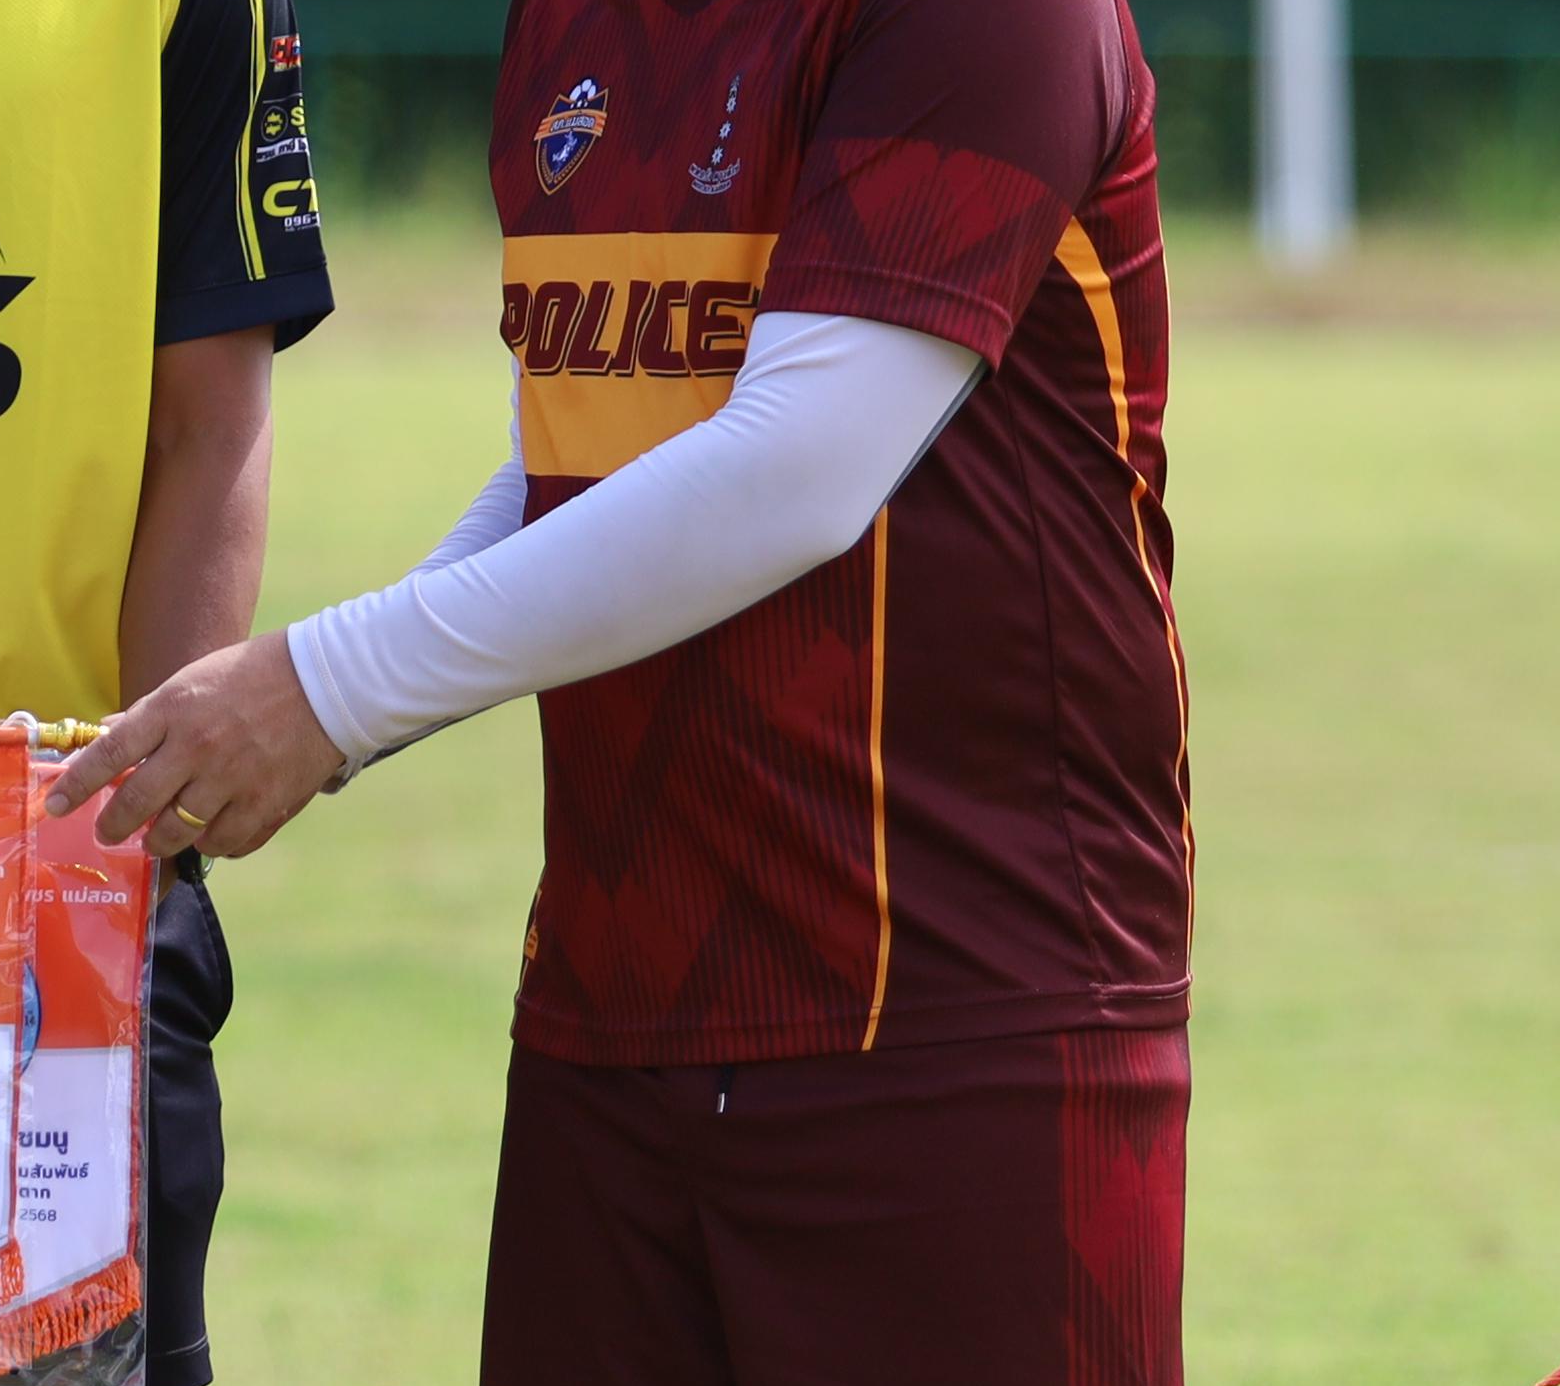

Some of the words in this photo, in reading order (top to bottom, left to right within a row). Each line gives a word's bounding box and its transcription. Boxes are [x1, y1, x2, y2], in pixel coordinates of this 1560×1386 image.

[502, 280, 760, 377] POLICE
[62, 887, 127, 904] แม่สอด
